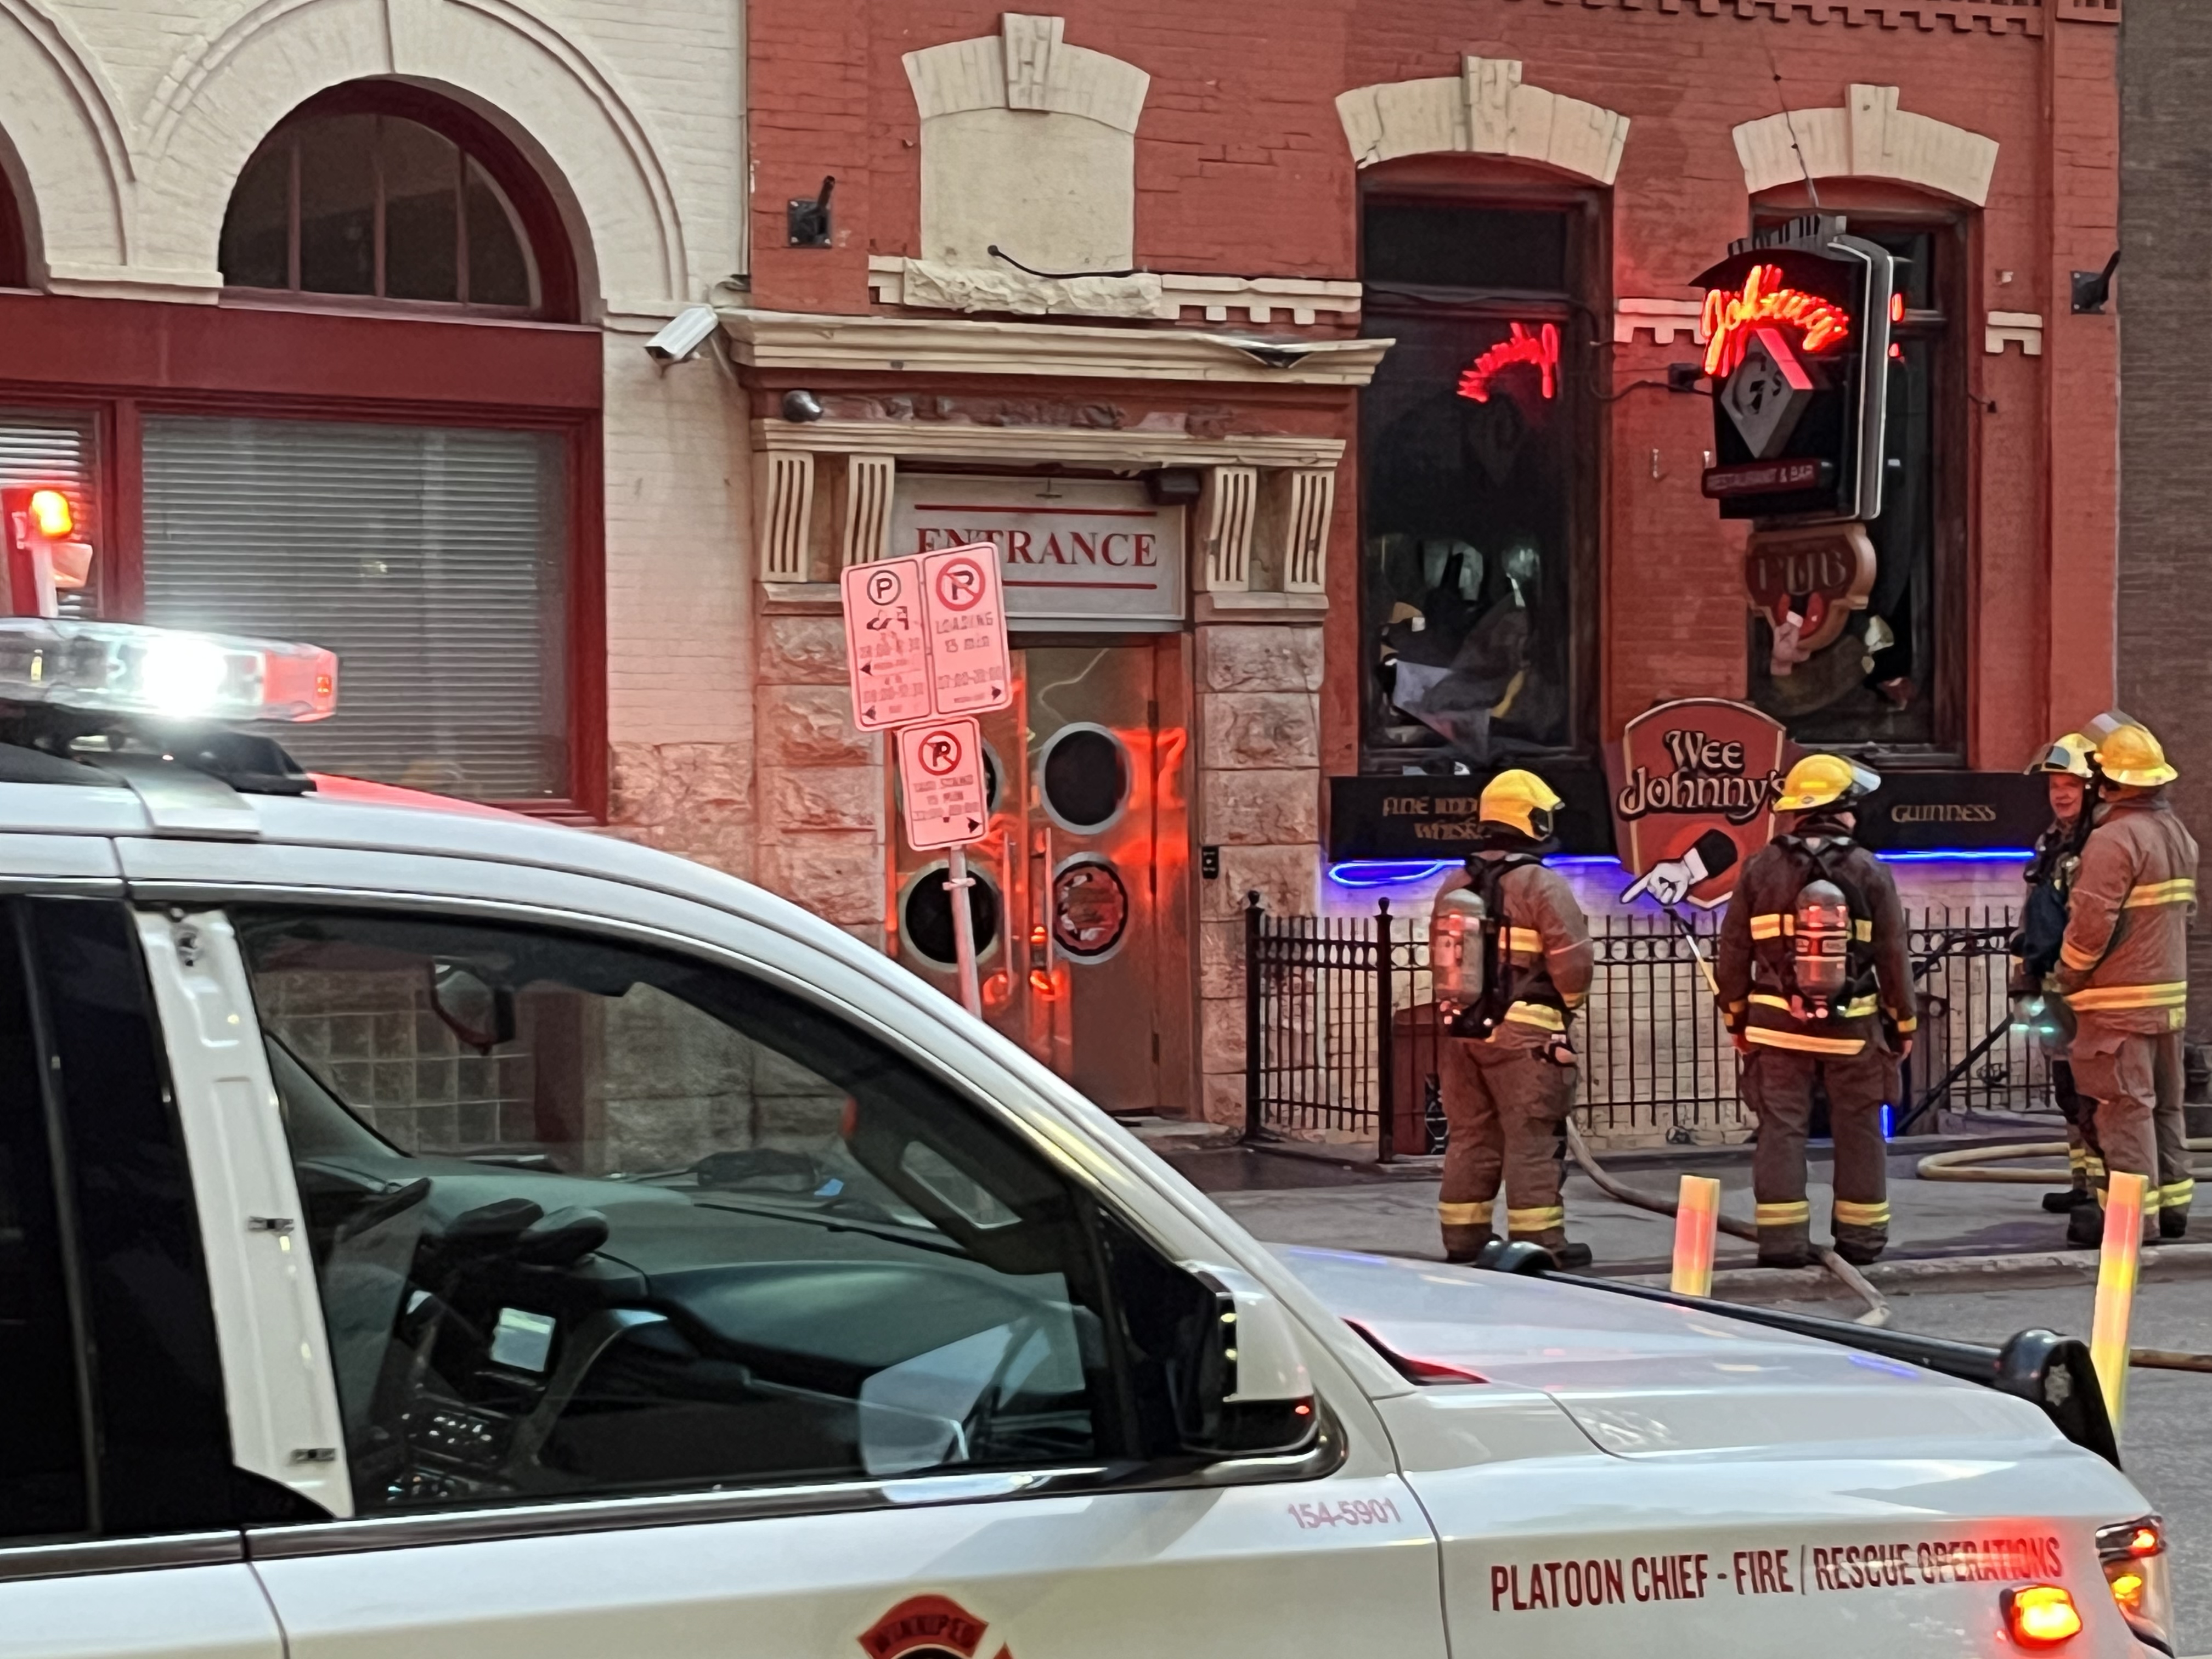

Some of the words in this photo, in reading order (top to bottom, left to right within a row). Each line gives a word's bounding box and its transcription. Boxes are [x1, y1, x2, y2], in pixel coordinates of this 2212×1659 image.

[1288, 1497, 1402, 1529] 154-5901
[1491, 1559, 1626, 1612] PLATOON
[1632, 1554, 1708, 1602] CHIEF
[1733, 1549, 1794, 1595] FIRE
[1813, 1543, 1916, 1590] RESCUE
[1917, 1536, 2063, 1584] OPERATIONS
